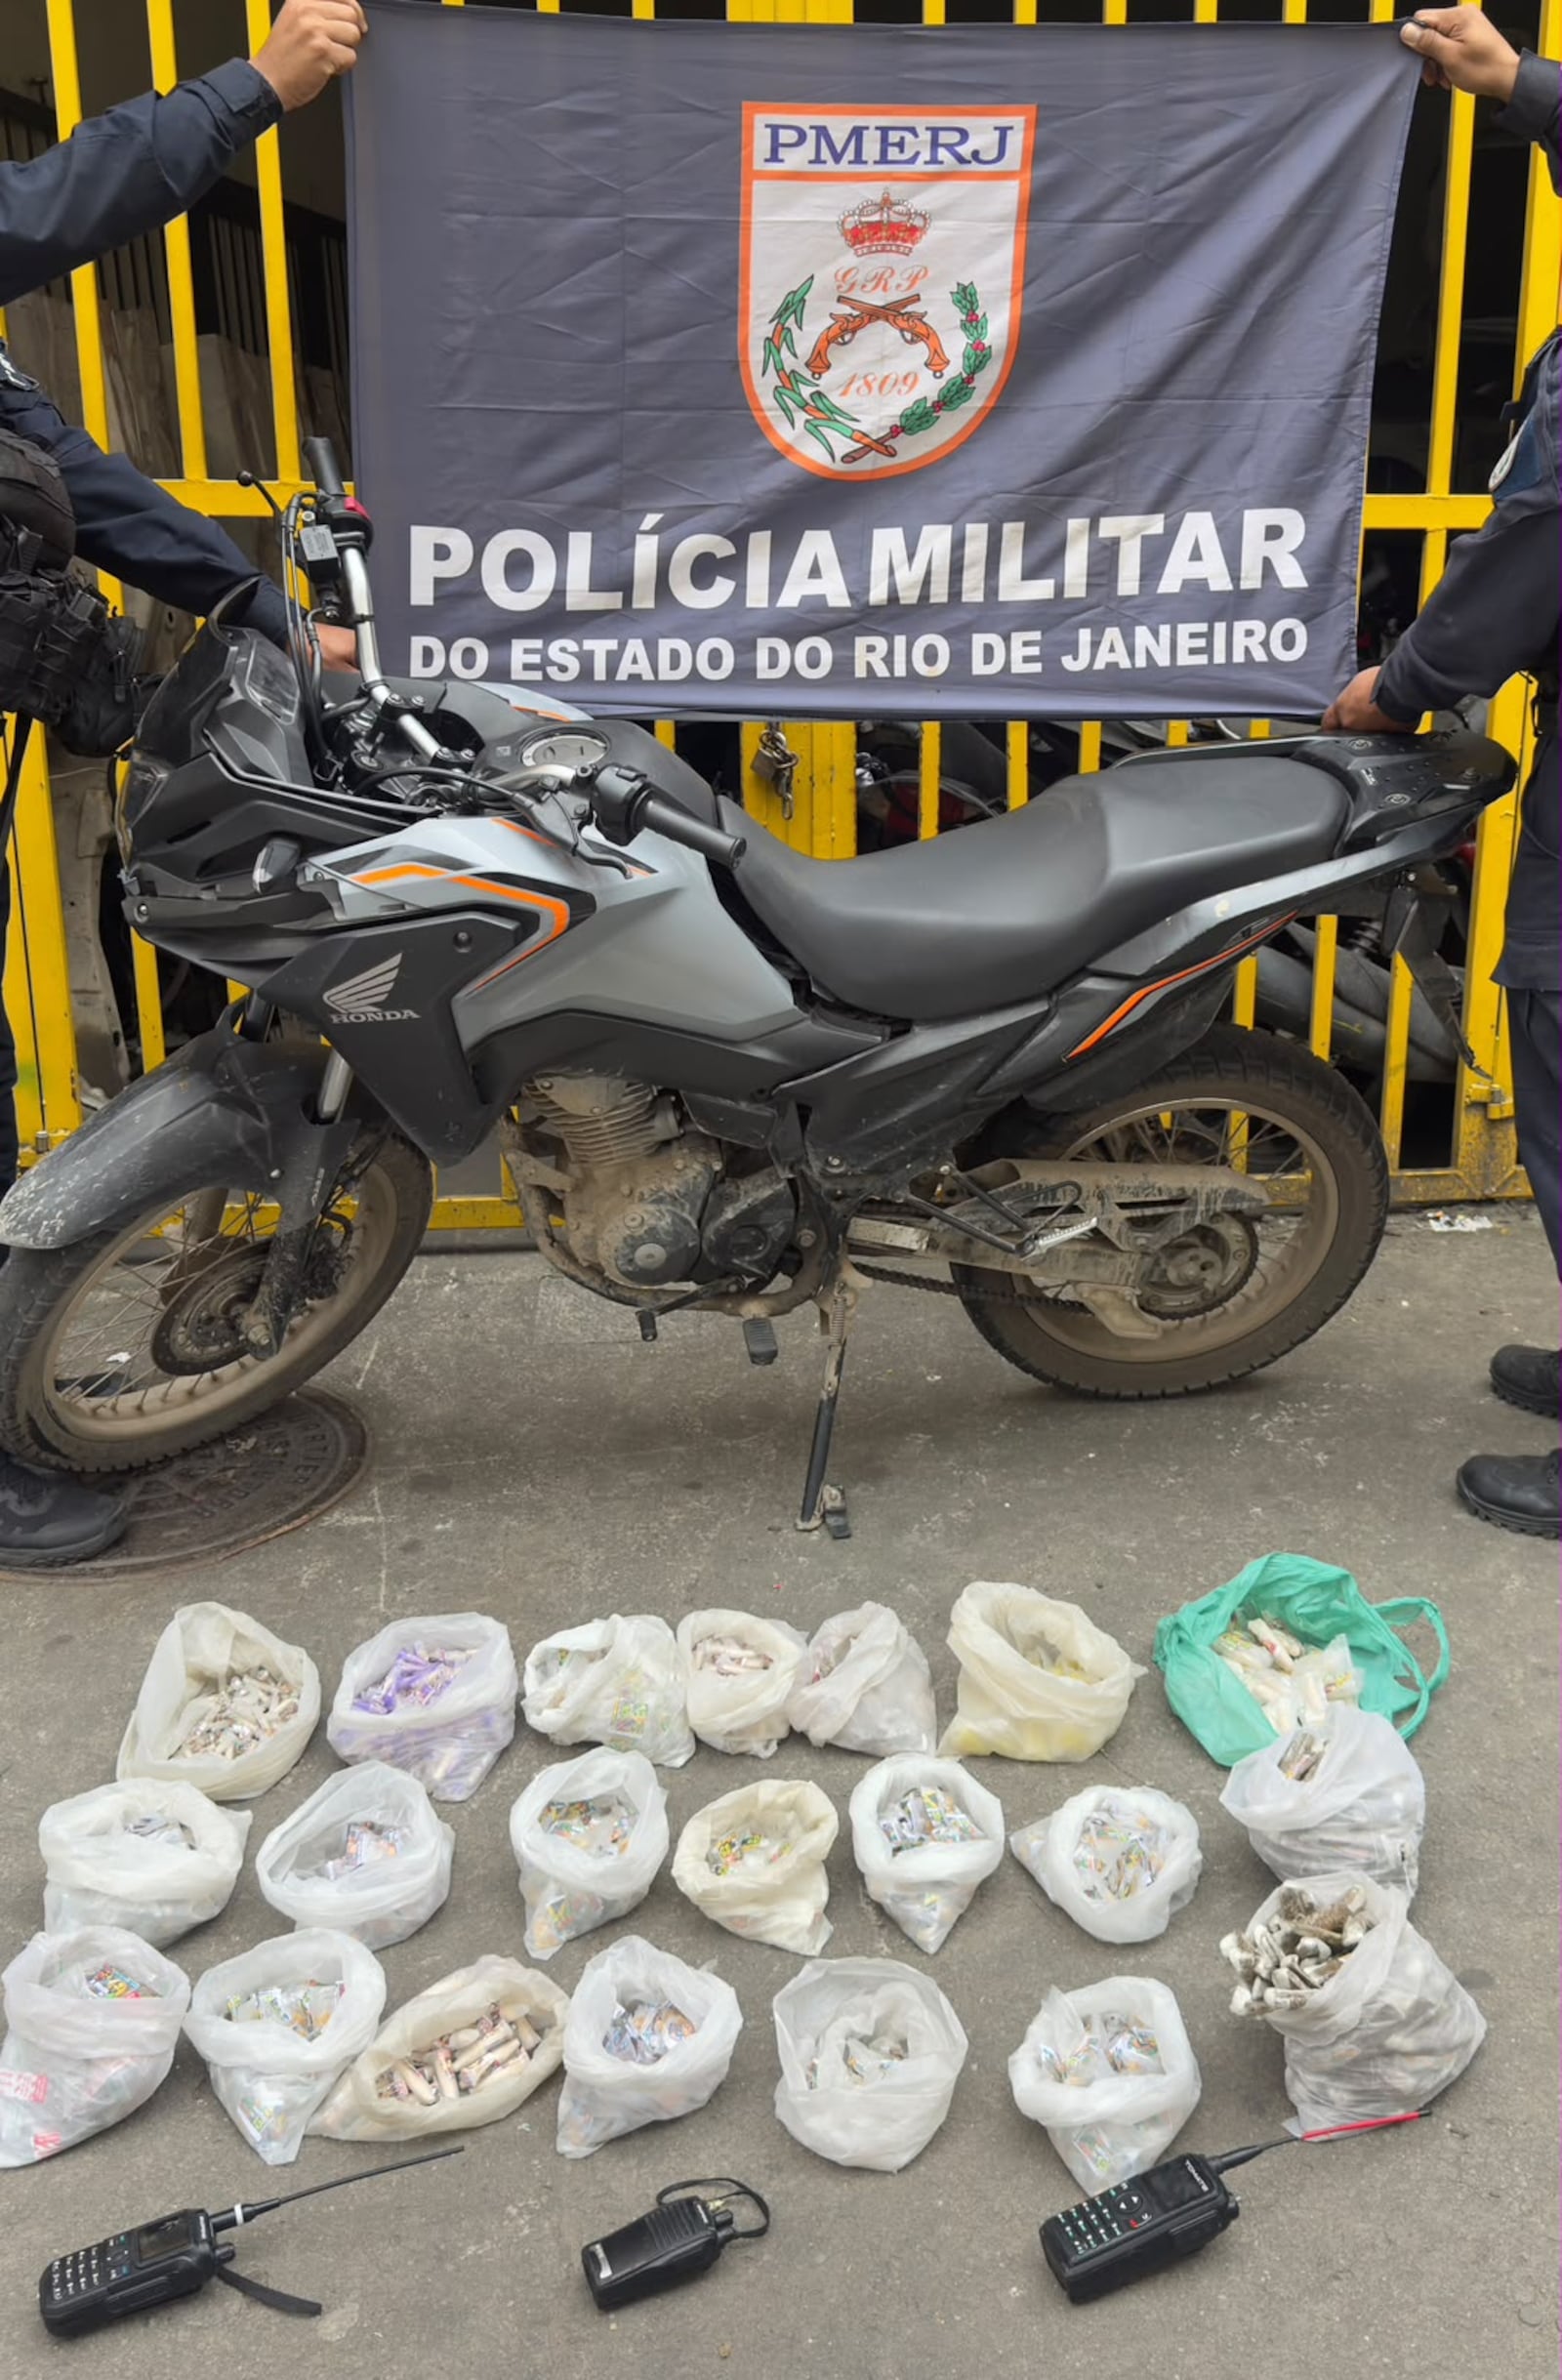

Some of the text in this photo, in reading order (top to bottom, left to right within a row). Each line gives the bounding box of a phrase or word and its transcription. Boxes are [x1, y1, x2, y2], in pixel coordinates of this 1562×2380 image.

[763, 123, 1013, 166] PMERJ
[834, 265, 929, 294] GRP
[839, 371, 920, 397] 1809
[409, 508, 1309, 612] POLÍCIA MILITAR
[409, 617, 1308, 681] DO ESTADO DO RIO DE JANEIRO
[331, 1008, 422, 1024] HONDA
